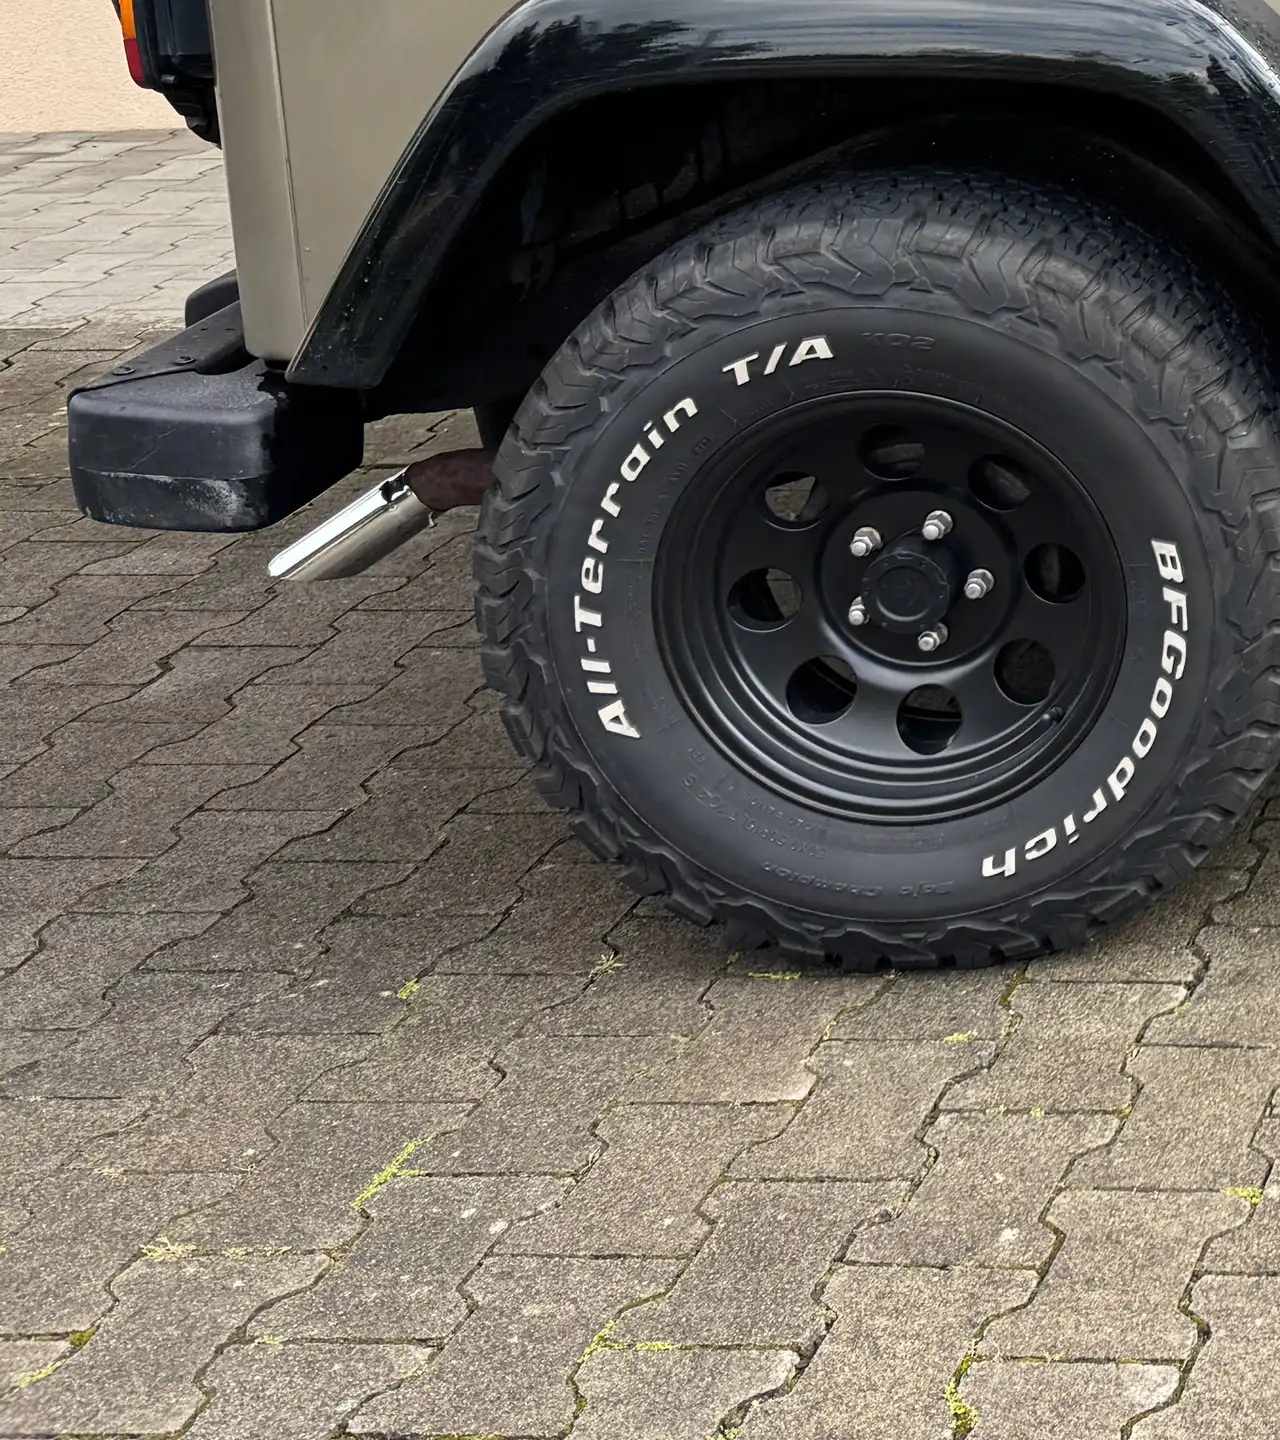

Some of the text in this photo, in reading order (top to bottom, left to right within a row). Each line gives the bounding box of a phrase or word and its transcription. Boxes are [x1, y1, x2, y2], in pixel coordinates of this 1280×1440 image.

[722, 332, 835, 388] T/A
[572, 394, 701, 740] All-Terrain
[980, 537, 1190, 881] BFGoodrich
